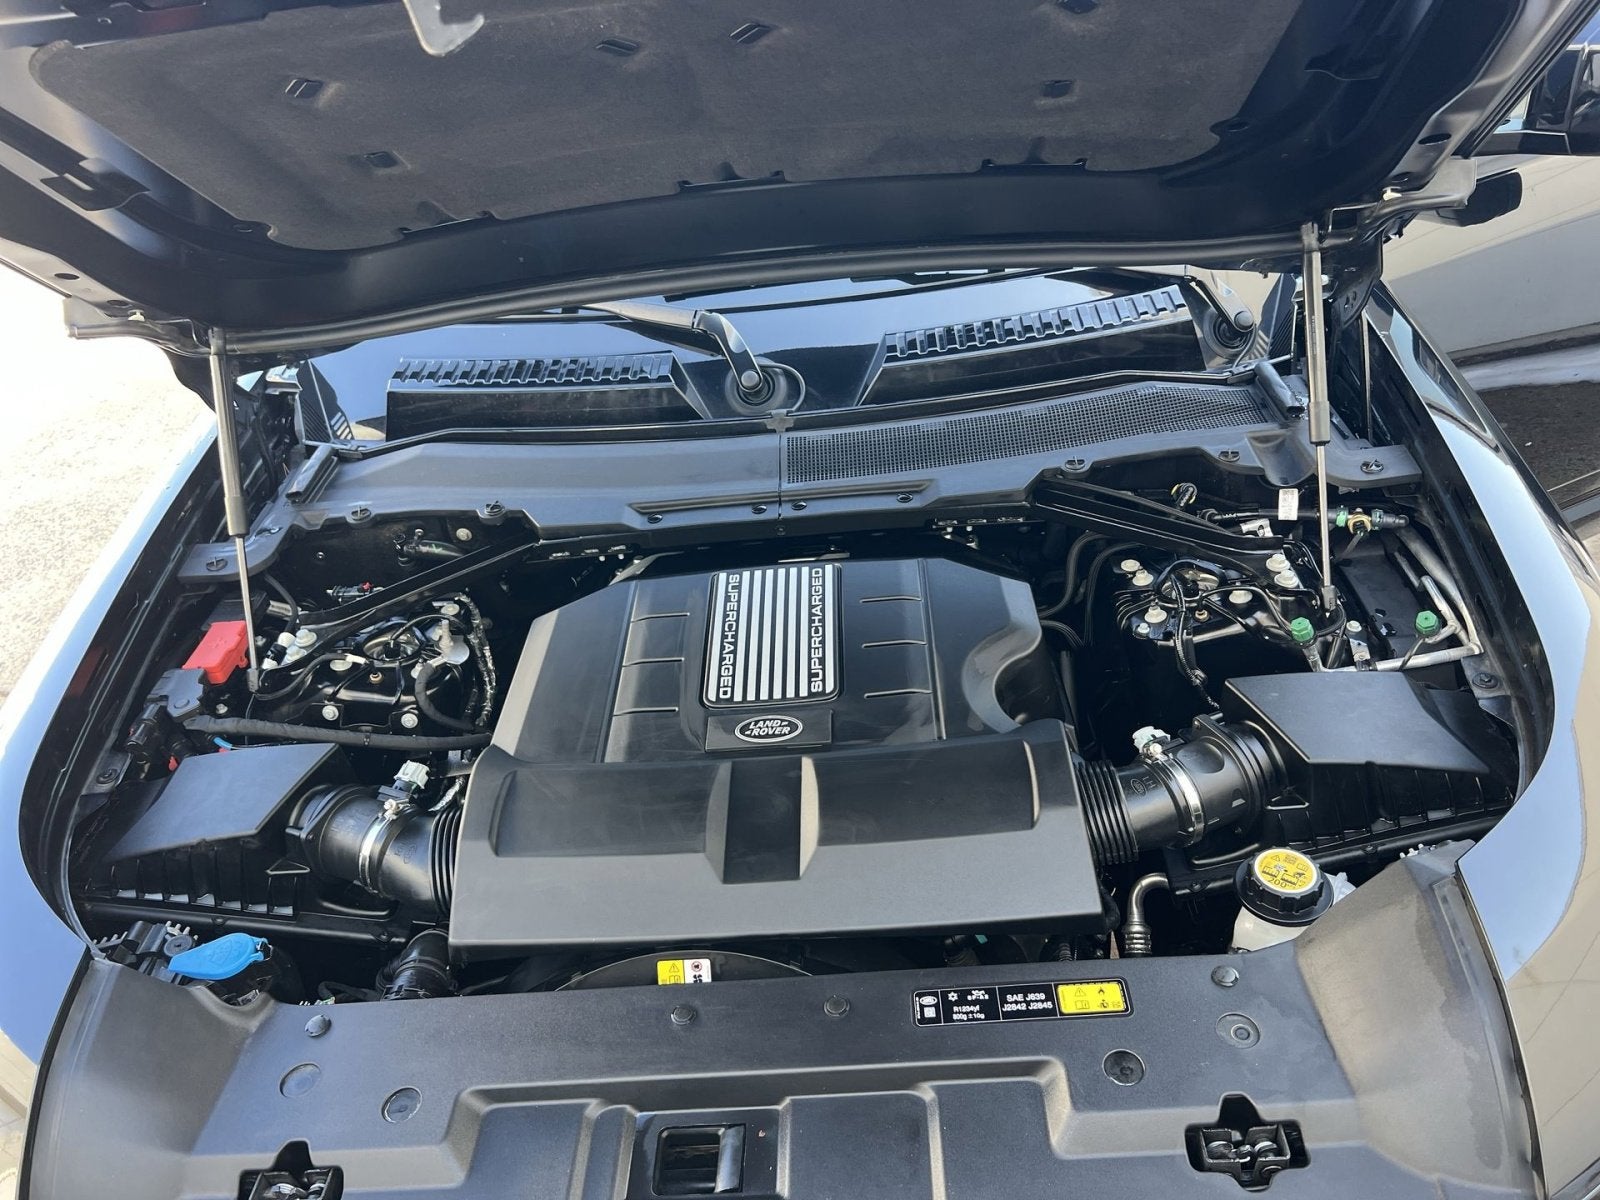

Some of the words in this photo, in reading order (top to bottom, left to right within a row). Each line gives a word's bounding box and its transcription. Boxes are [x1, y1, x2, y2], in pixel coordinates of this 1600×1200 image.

[811, 568, 823, 693] SUPERCHARGED
[719, 574, 740, 699] SUPERCHARGED
[749, 719, 781, 729] LAND
[751, 726, 791, 736] ROVER
[1006, 994, 1024, 1002] SAE
[1026, 993, 1046, 1001] J639
[1002, 1003, 1027, 1012] J2842
[1028, 1001, 1053, 1010] J2845
